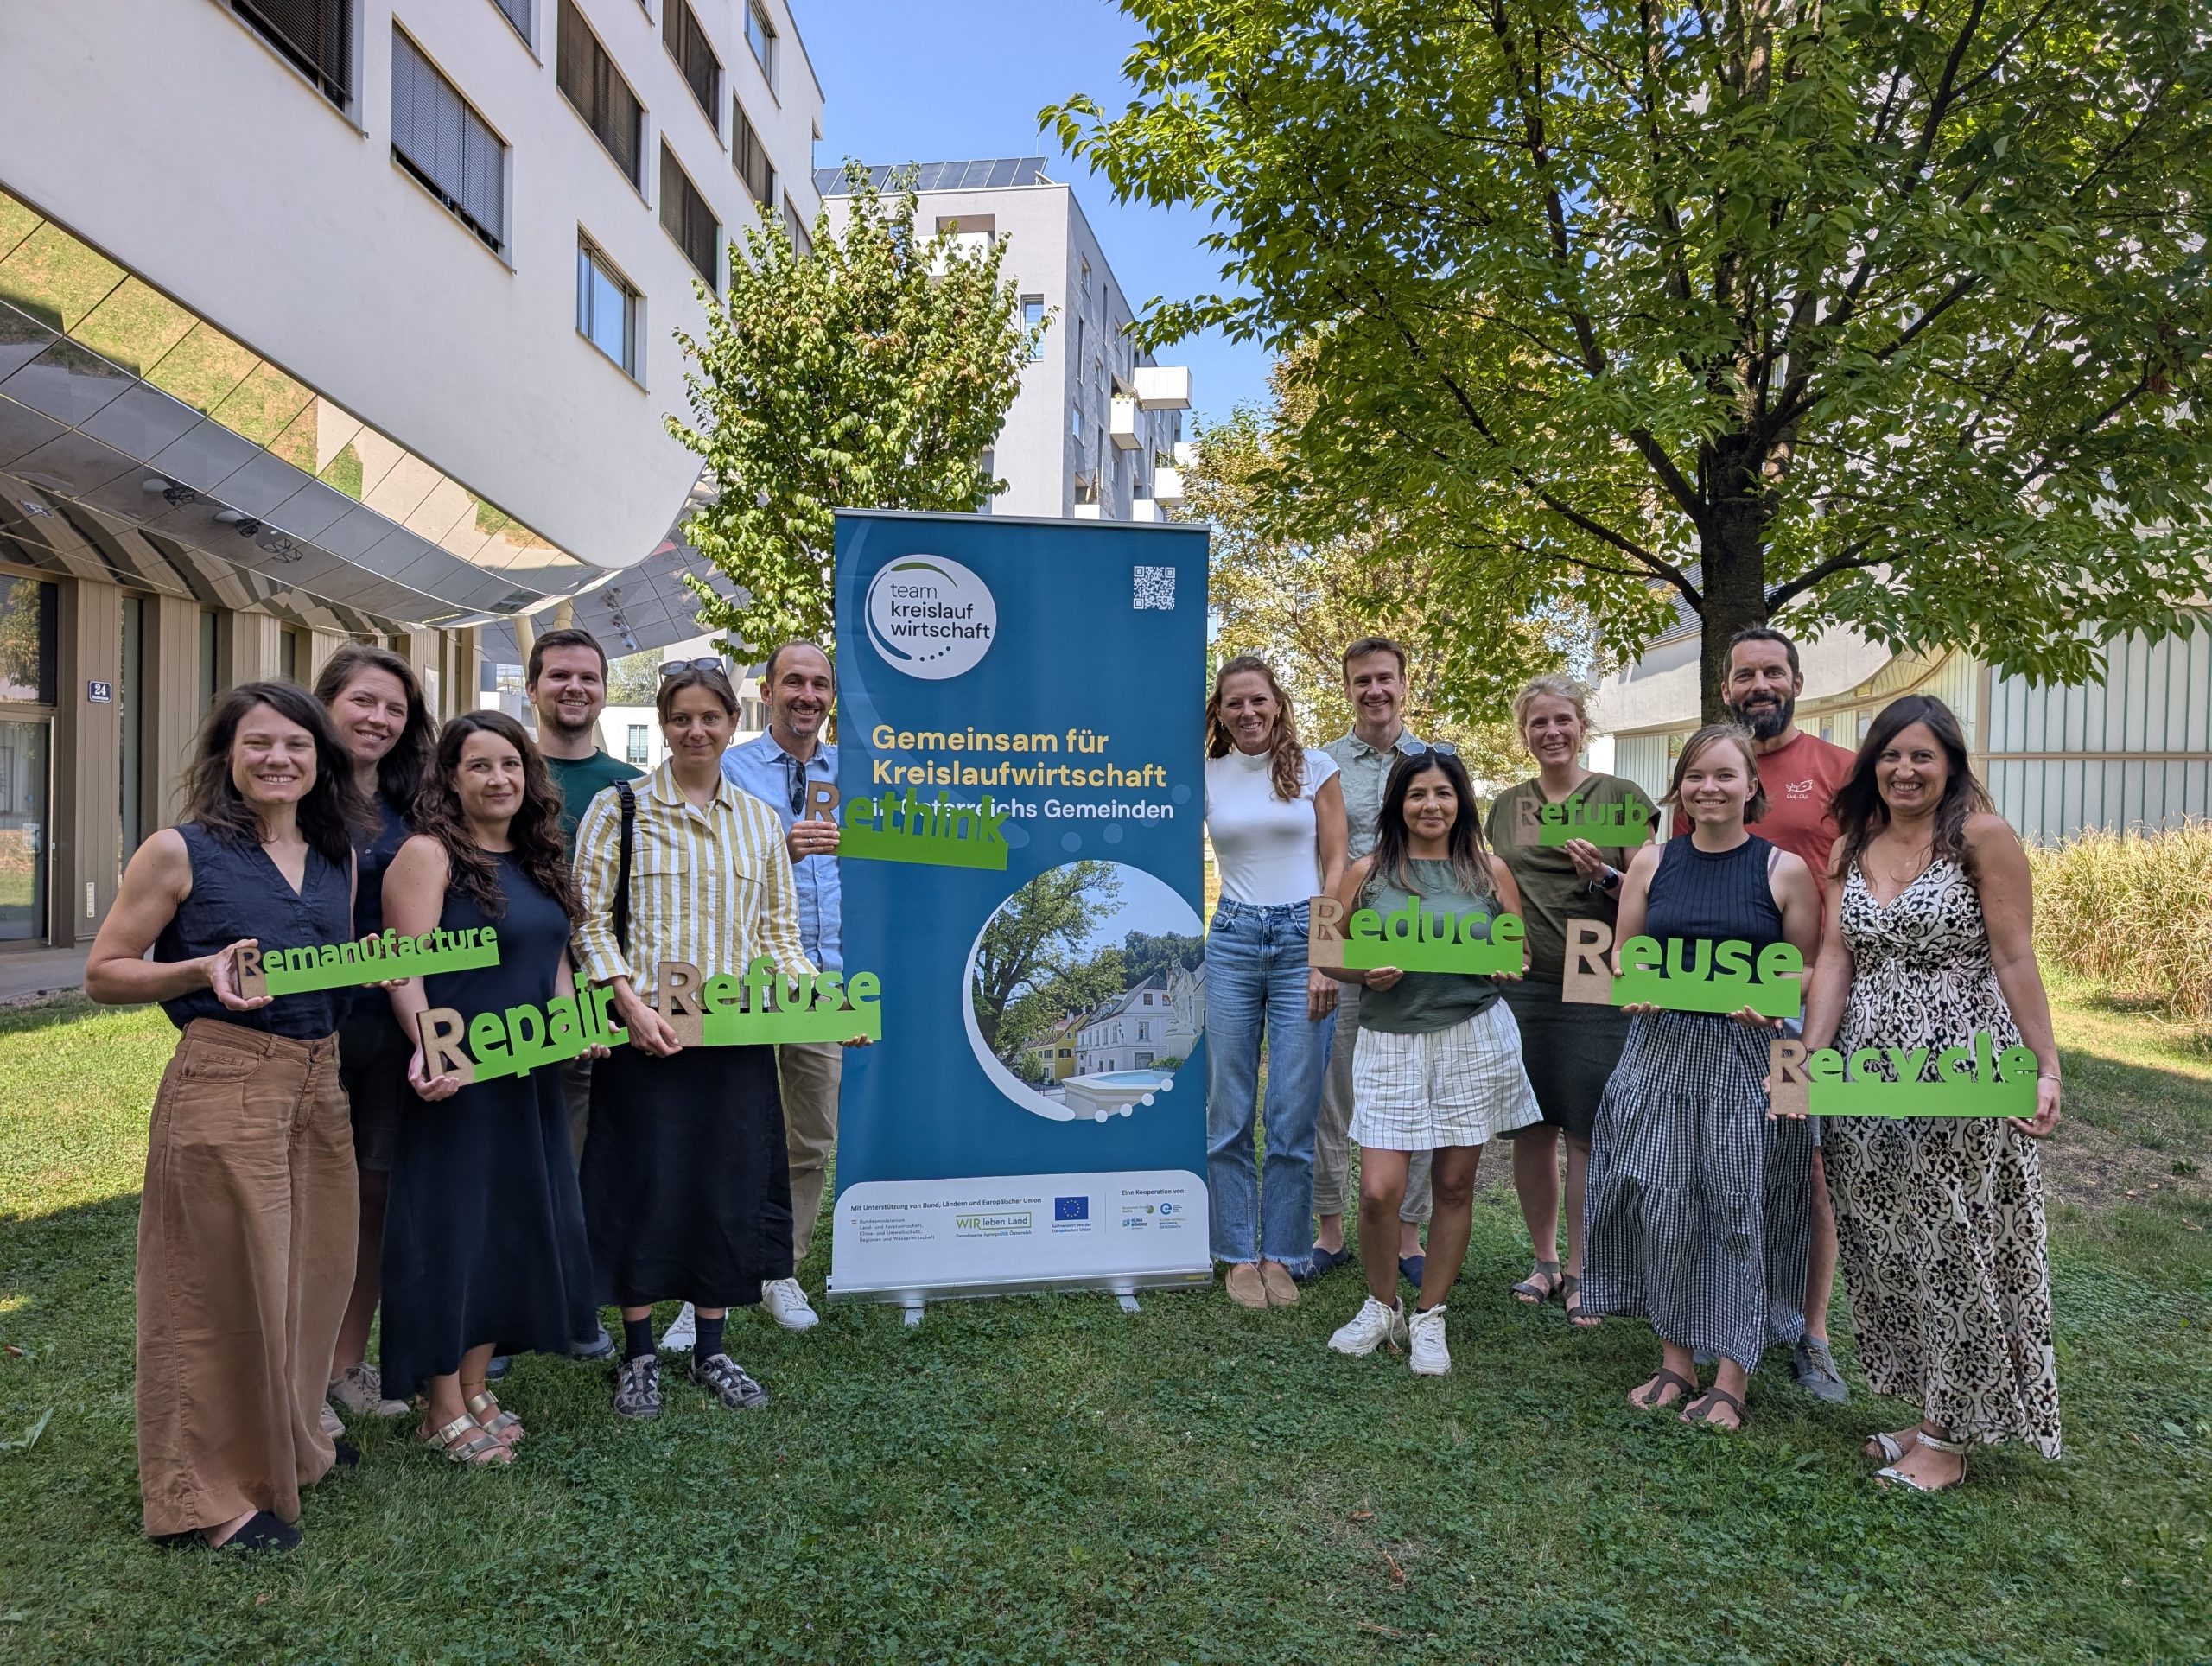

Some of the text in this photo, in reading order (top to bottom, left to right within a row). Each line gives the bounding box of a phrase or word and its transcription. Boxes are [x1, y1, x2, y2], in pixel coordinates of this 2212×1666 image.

[890, 582, 938, 599] team
[891, 600, 974, 620] kreislauf
[890, 620, 991, 639] wirtschaft
[94, 684, 106, 696] 24
[872, 724, 1109, 754] Gemeinsam für
[873, 759, 1166, 787] Kreislaufwirtschaft
[805, 780, 1011, 844] Rethink
[1044, 799, 1174, 819] Gemeinden
[1516, 792, 1649, 827] Refurb
[1308, 895, 1525, 947] Reduce
[234, 925, 499, 978] Remanufacture
[1565, 918, 1805, 987] Reuse
[658, 956, 881, 1015] Refuse
[416, 972, 617, 1078] Repair
[1770, 1032, 2039, 1118] Recycle
[956, 1216, 1028, 1229] WIR leben Land
